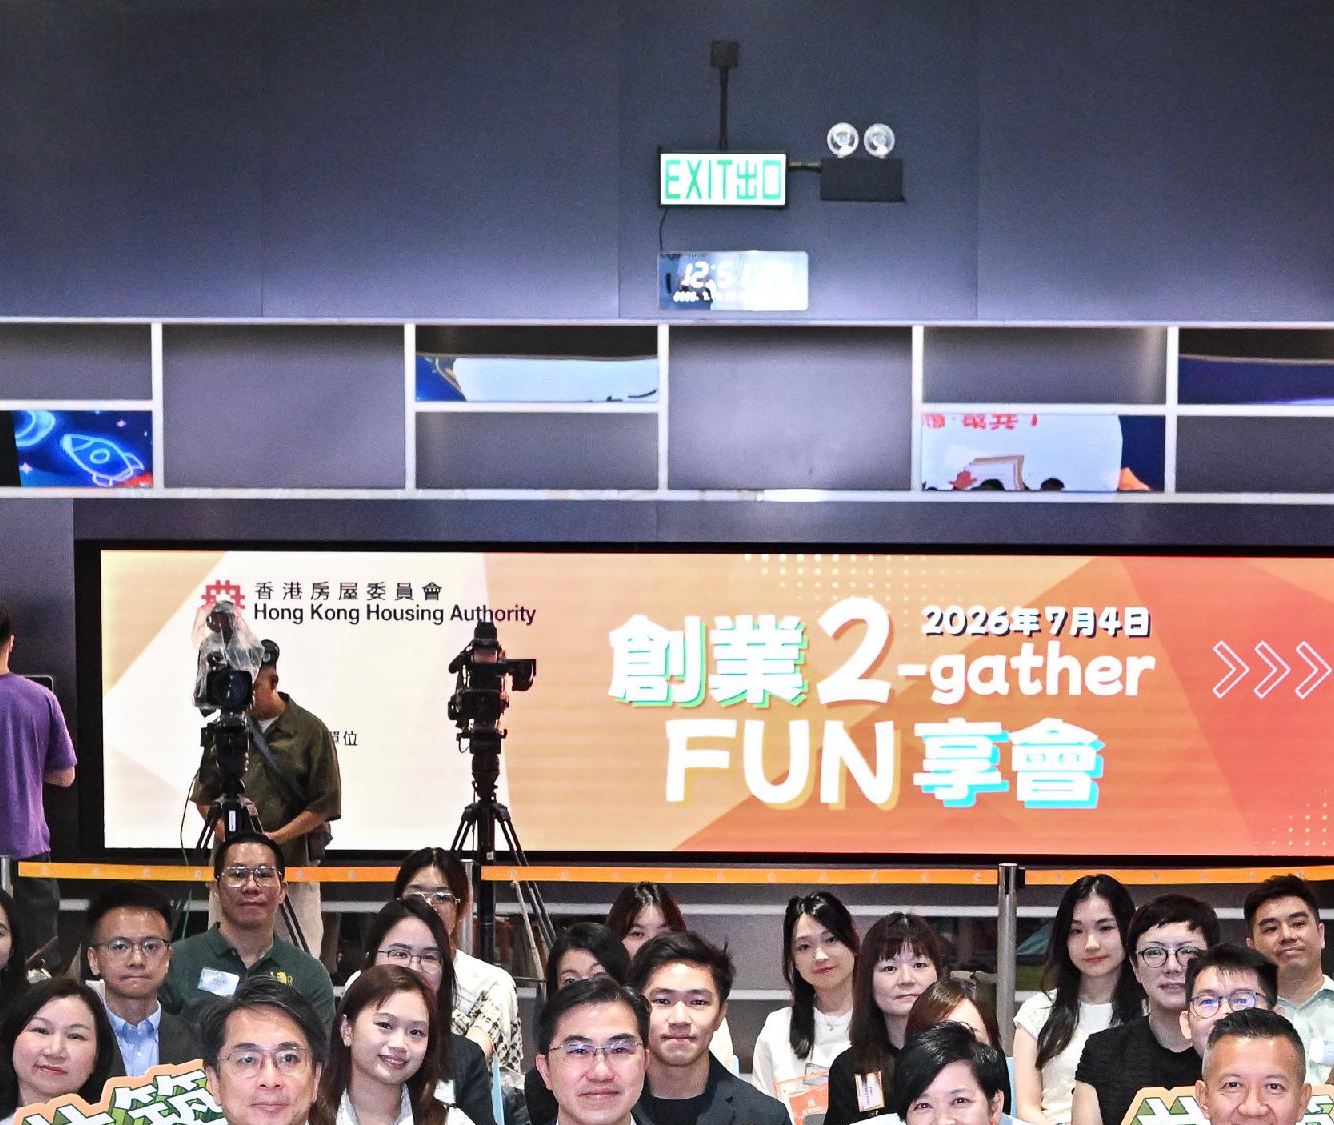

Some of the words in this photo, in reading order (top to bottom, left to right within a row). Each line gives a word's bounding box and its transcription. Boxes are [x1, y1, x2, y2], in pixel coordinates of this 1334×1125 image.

[667, 160, 733, 200] EXIT
[736, 160, 782, 200] 出口
[254, 581, 443, 602] 香港房屋委員會
[254, 604, 304, 624] Hong
[311, 604, 360, 624] Kong
[366, 604, 445, 625] Housing
[450, 604, 537, 626] Authority
[921, 605, 1151, 638] 2026年7月4日
[608, 615, 809, 707] 創業
[665, 719, 895, 806] FUN
[913, 717, 1106, 809] 享會
